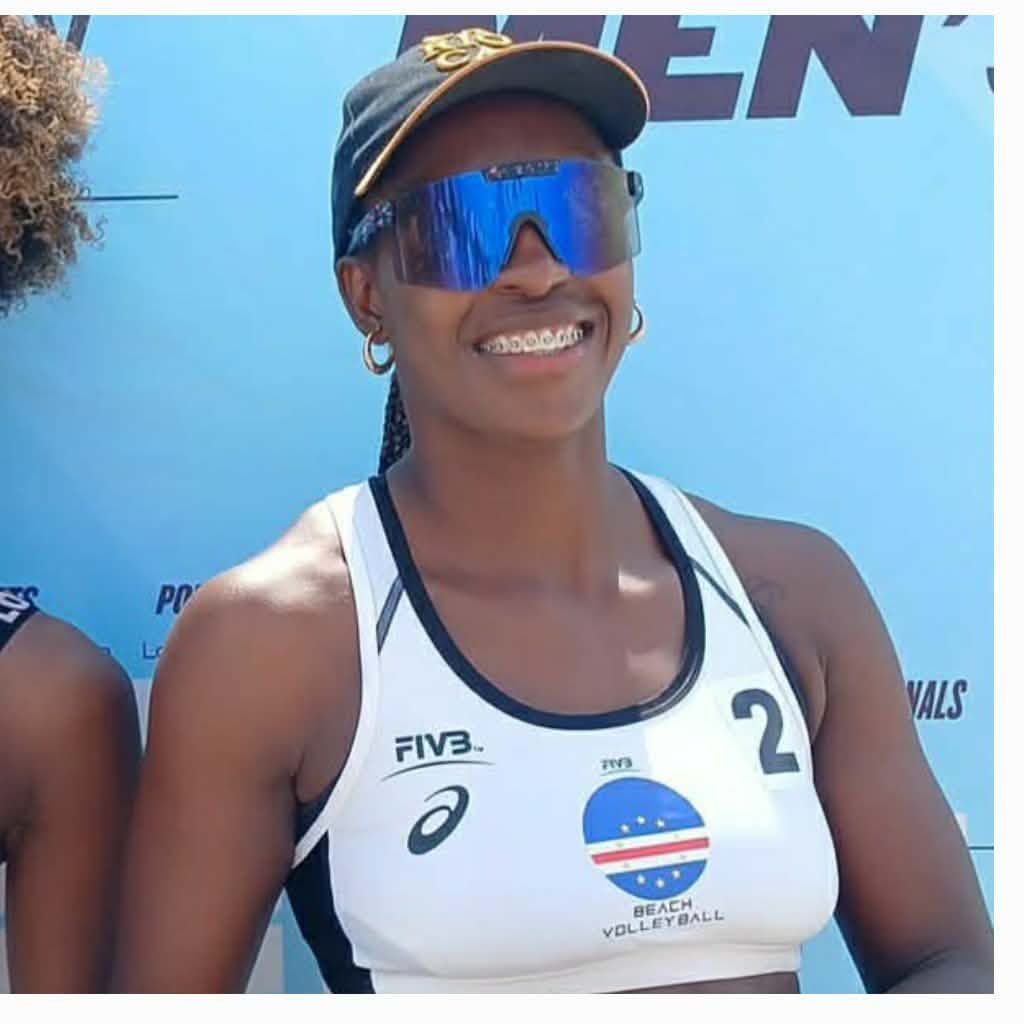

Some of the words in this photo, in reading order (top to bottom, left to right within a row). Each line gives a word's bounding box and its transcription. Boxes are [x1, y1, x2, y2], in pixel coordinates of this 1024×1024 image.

[395, 730, 472, 763] FIVB
[731, 687, 800, 775] 2
[602, 909, 725, 938] VOLLEYBALL
[633, 898, 692, 918] BEACH
